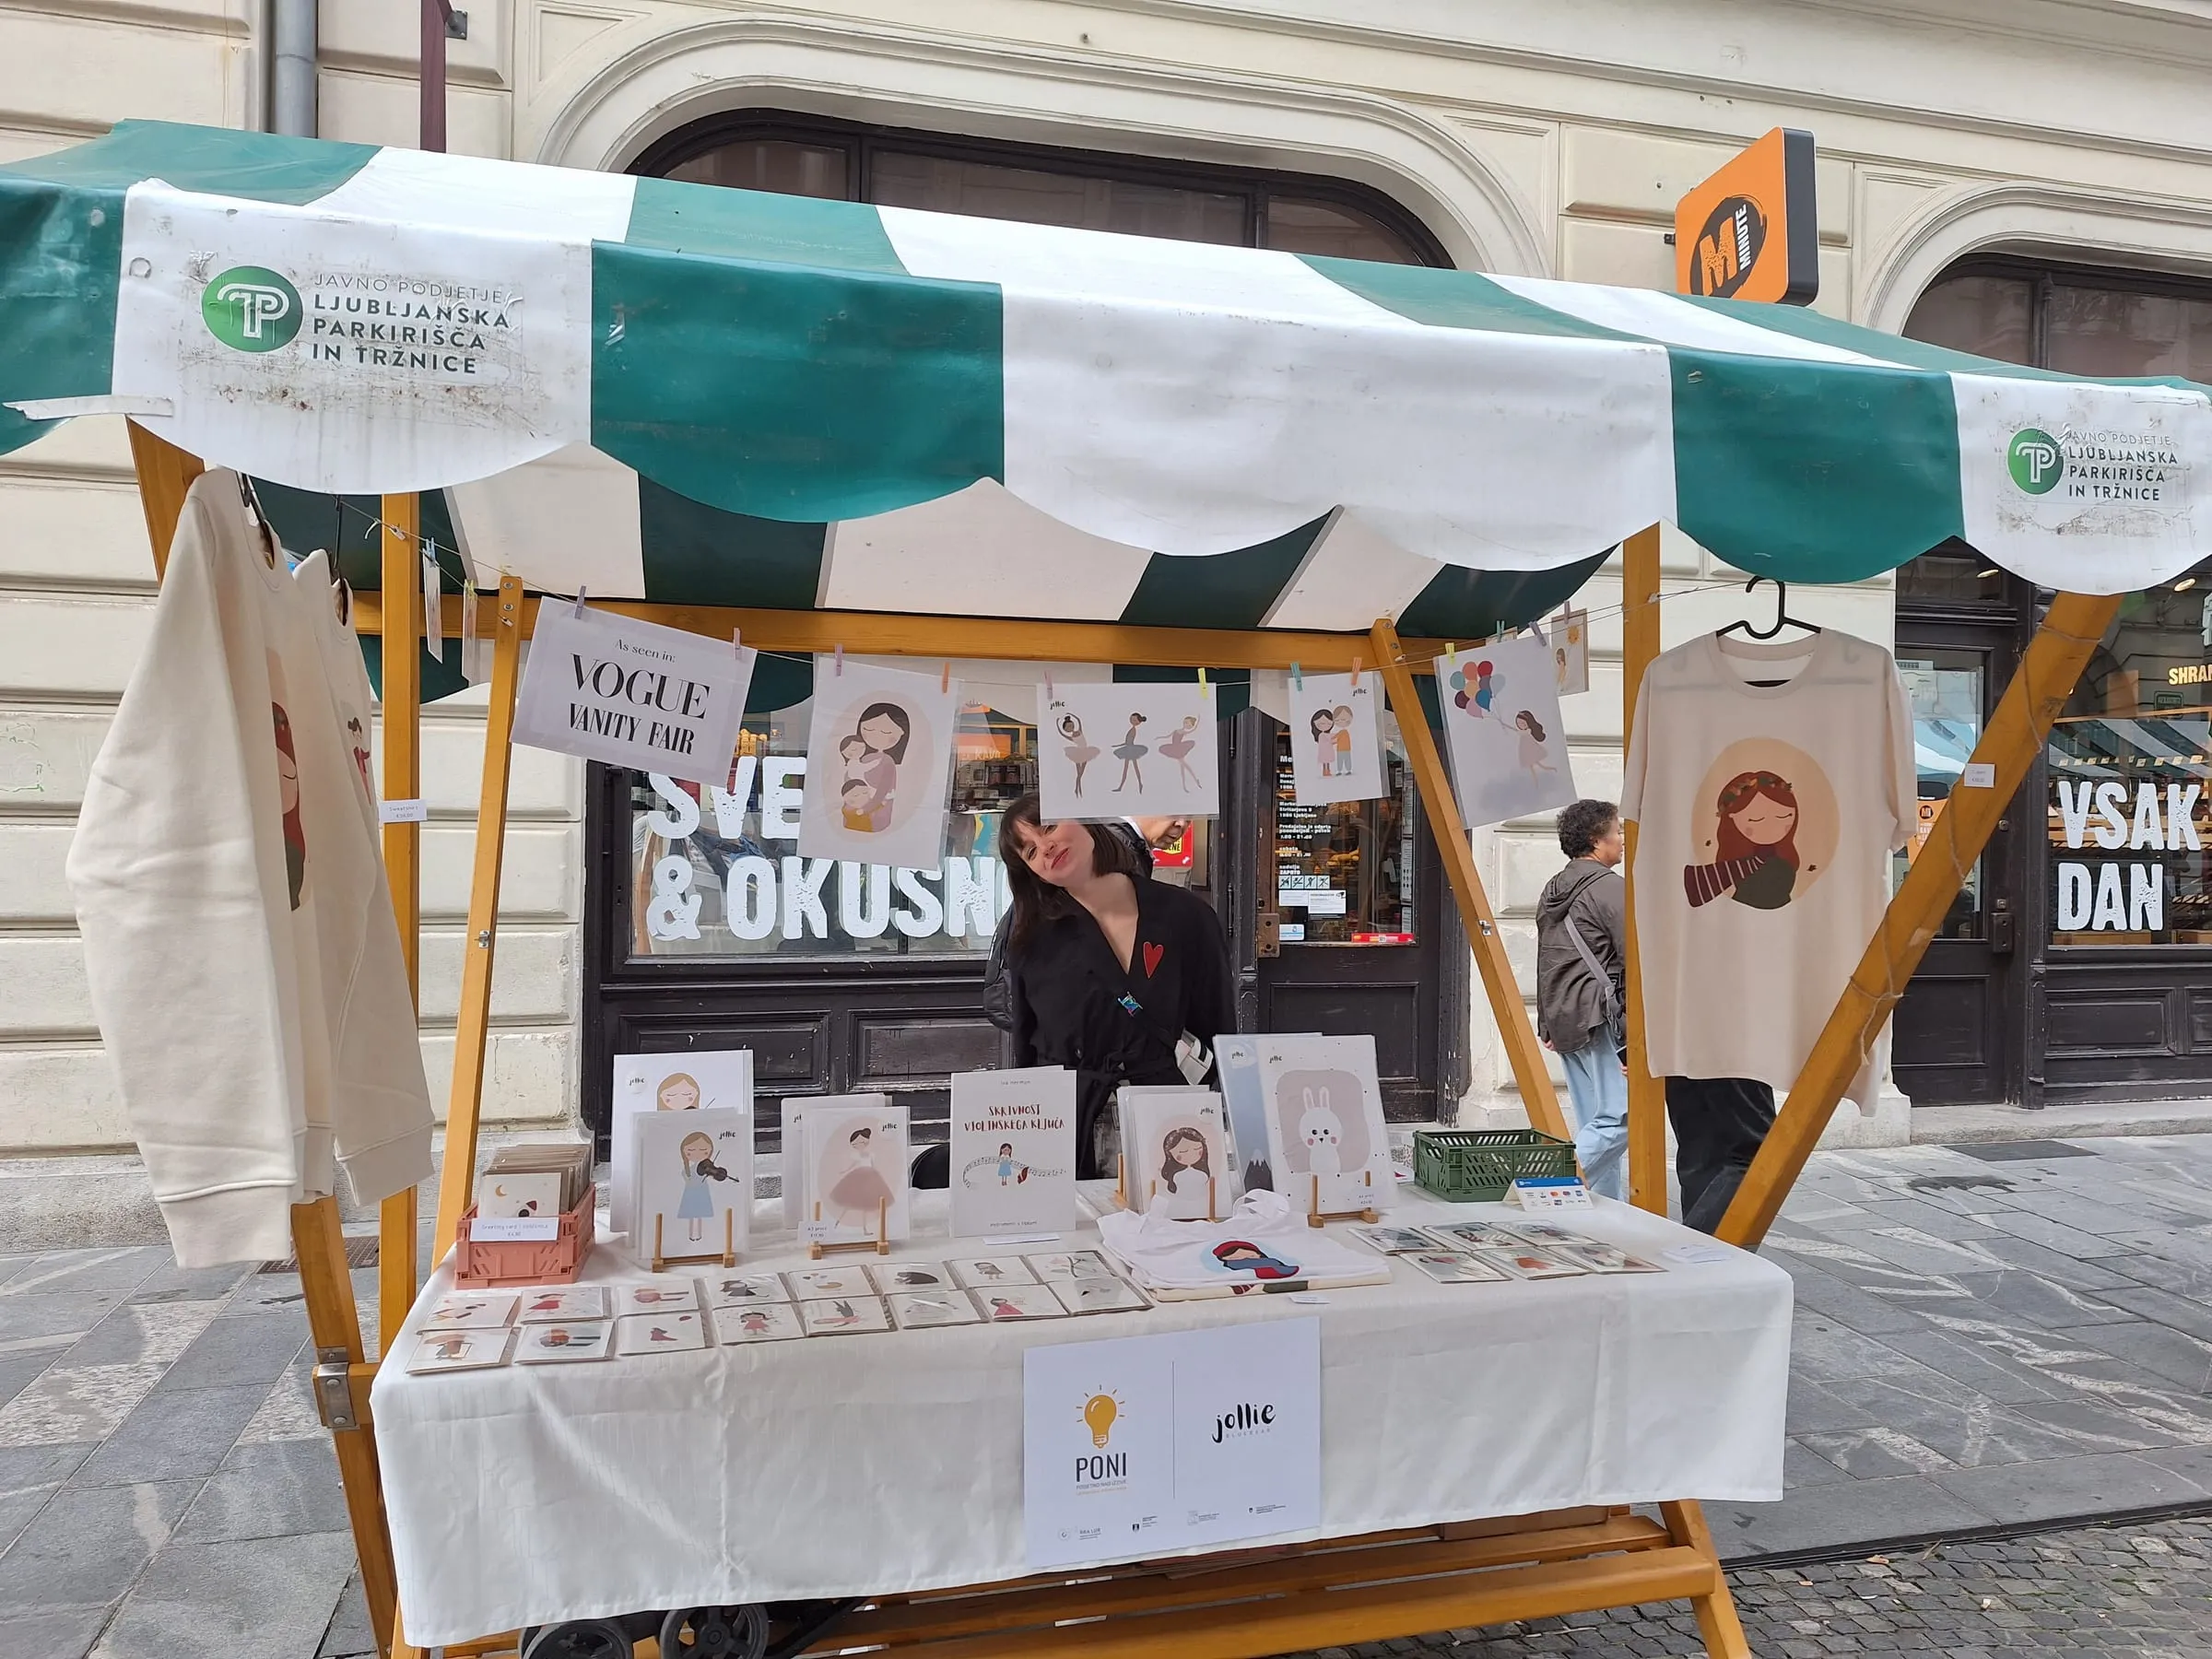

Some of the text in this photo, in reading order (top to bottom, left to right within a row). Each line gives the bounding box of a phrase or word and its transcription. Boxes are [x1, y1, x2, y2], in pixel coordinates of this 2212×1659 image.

[1735, 204, 1752, 271] MINUTE
[315, 273, 503, 304] JAVNO PODJETJE
[314, 295, 510, 329] LJUBLJANSKA
[313, 318, 486, 350] PARKIRIŠČA
[312, 345, 477, 374] IN TRŽNICE
[2112, 433, 2171, 446] PODJETJE
[2068, 446, 2178, 465] LJUBLJANSKA
[2069, 465, 2165, 483] PARKIRIŠČA
[2069, 483, 2159, 501] IN TRŽNICE
[615, 639, 676, 663] As seen in:
[570, 653, 711, 720] VOGUE
[570, 702, 695, 756] VANITY FAIR
[2058, 781, 2202, 851] VSAK
[646, 855, 1014, 941] & OKUSN
[2057, 863, 2164, 931] DAN
[964, 1116, 1065, 1132] VIOLINSKEGA KLJUČA
[988, 1104, 1041, 1117] SKRIVNOST
[1211, 1403, 1277, 1443] jollie
[1076, 1452, 1126, 1483] PONI
